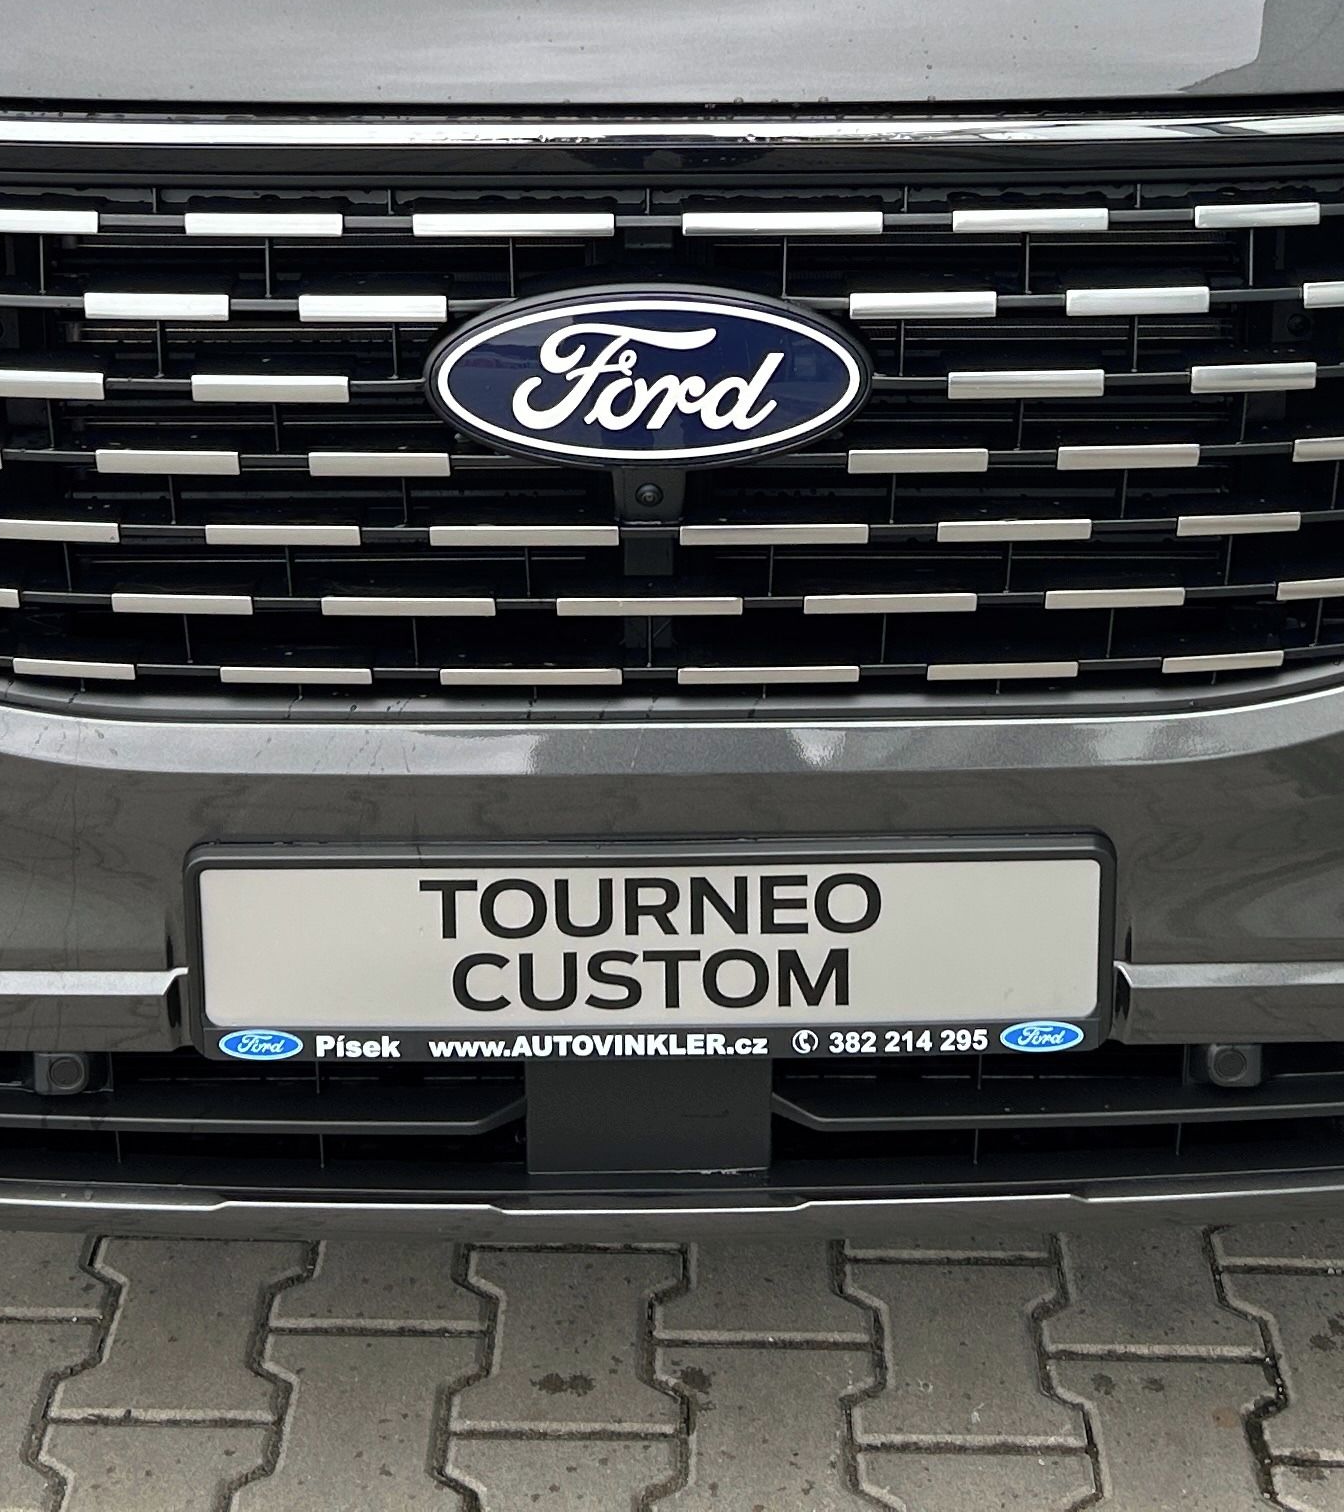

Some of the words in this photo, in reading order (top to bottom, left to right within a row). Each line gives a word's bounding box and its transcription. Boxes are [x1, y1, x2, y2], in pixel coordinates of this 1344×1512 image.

[511, 322, 786, 431] Ford
[418, 872, 883, 940] TOURNEO
[451, 947, 851, 1012] CUSTOM
[315, 1034, 402, 1059] Písek
[427, 1032, 769, 1058] www.AUTOVINKLER.cz
[828, 1030, 878, 1054] 382
[883, 1029, 934, 1053] 214
[939, 1028, 989, 1052] 295
